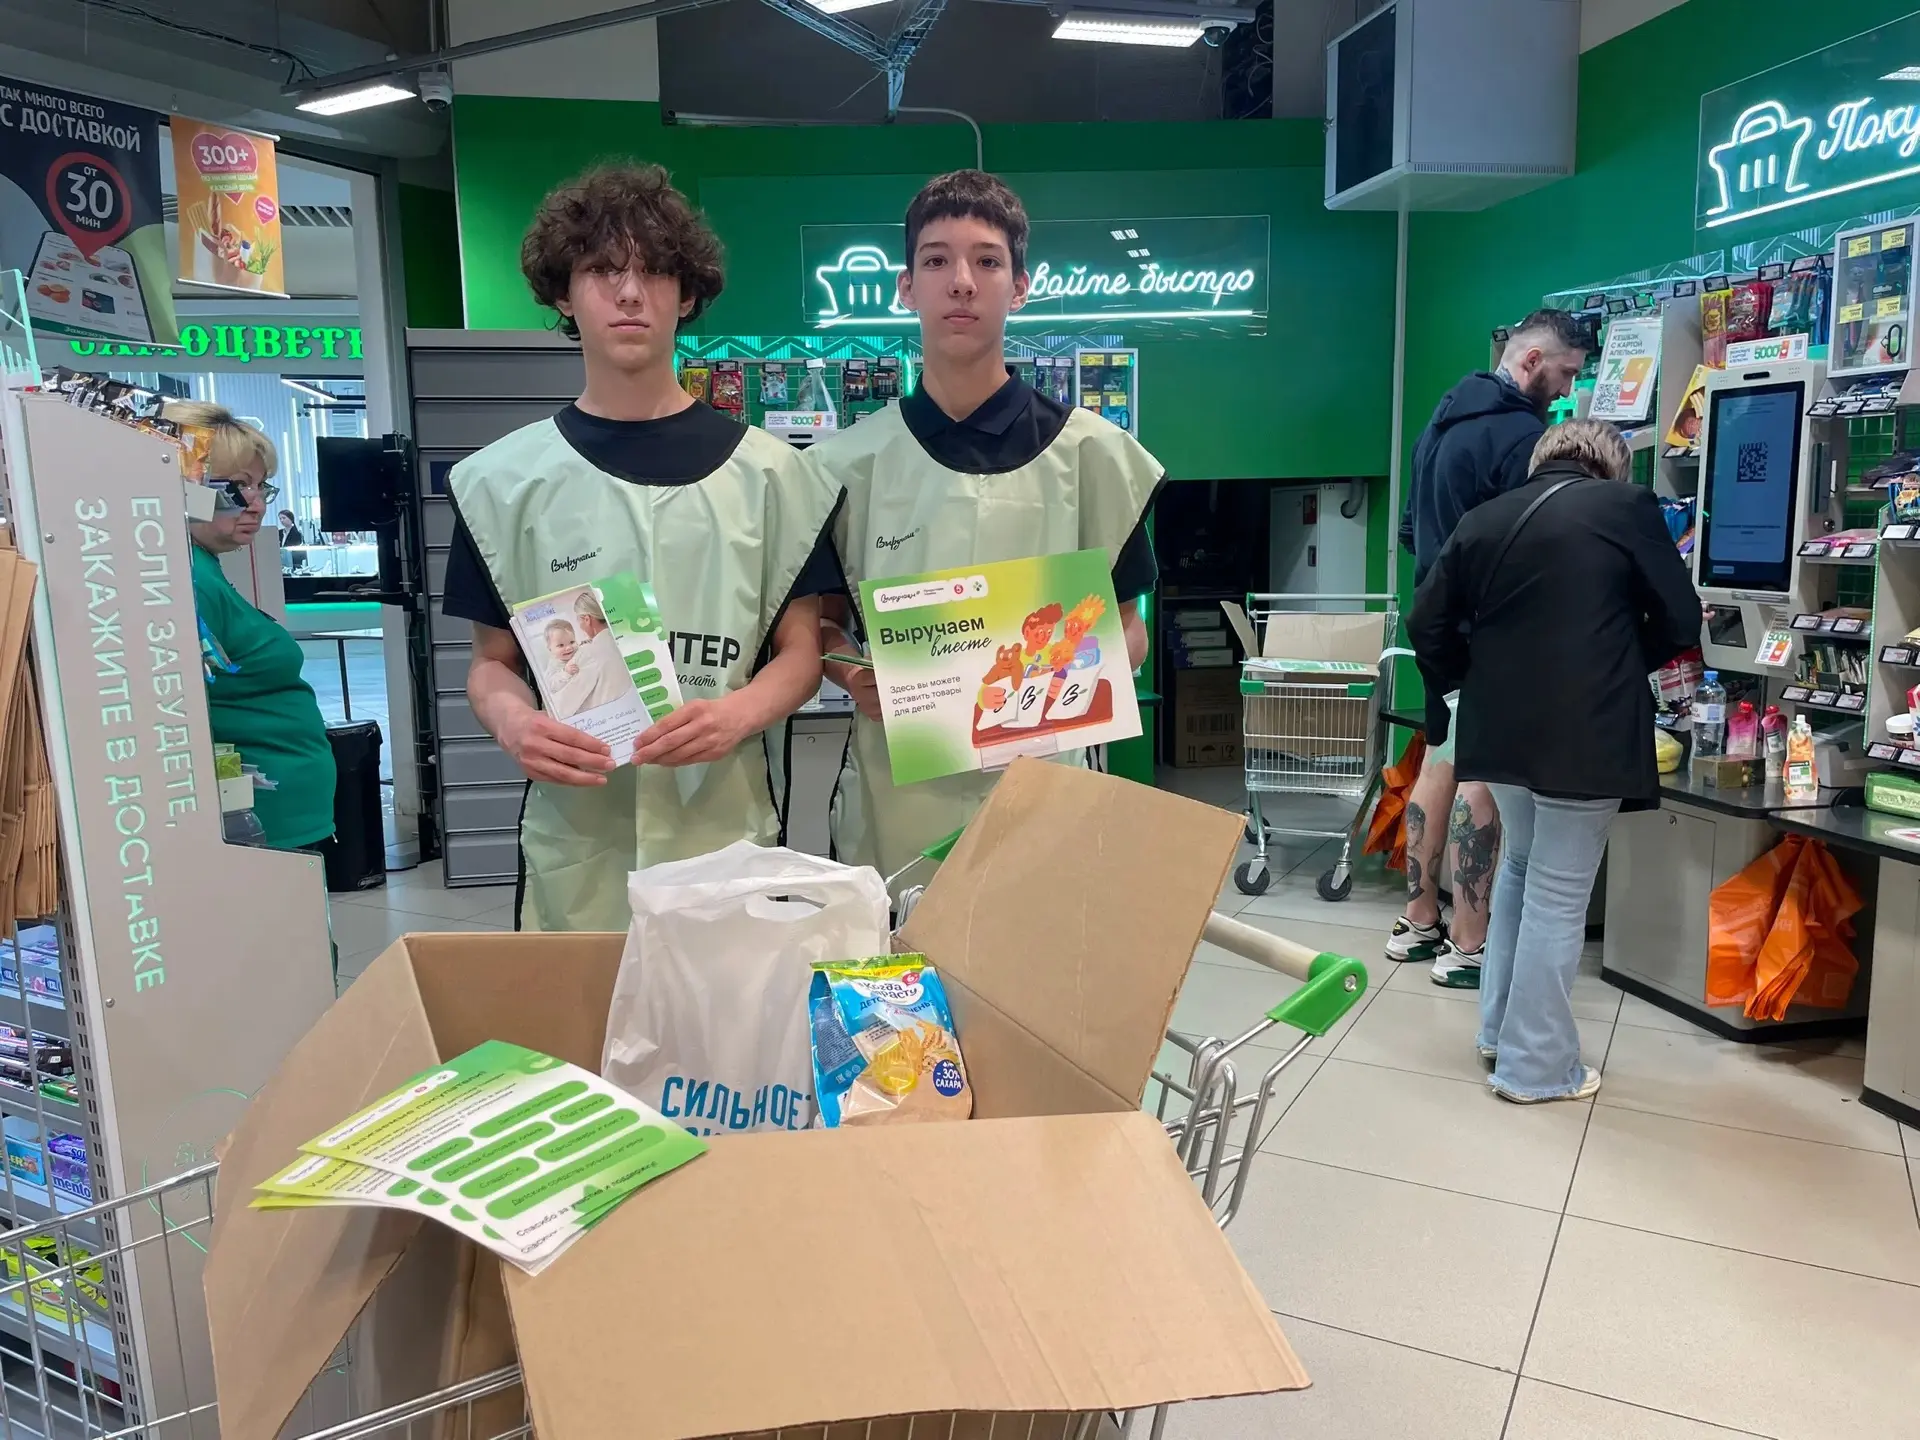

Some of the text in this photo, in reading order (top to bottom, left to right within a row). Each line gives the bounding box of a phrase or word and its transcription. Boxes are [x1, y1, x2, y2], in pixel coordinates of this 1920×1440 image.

[25, 90, 67, 111] МНОГО
[70, 101, 104, 119] ВСЕГО
[0, 104, 141, 153] С ДОСТАВКОЙ
[1818, 96, 1920, 161] Поку
[198, 145, 249, 166] 300+
[66, 171, 114, 219] 30
[1028, 261, 1255, 306] вайте быстро
[1617, 341, 1643, 349] КАРТОЙ
[880, 617, 985, 646] Выручаем
[930, 635, 993, 657] вместе
[130, 497, 198, 828] ЕСЛИ ЗАБУДЕТЕ,
[890, 675, 961, 695] Здесь вы можете
[892, 687, 962, 706] оставить товары
[894, 701, 937, 718] для детей
[75, 497, 167, 993] ЗАКАЖИТЕ В ДОСТАВКЕ
[935, 1079, 963, 1089] САХАРА
[53, 1176, 92, 1199] mento
[516, 1212, 558, 1238] Спасибо
[558, 1206, 570, 1218] за
